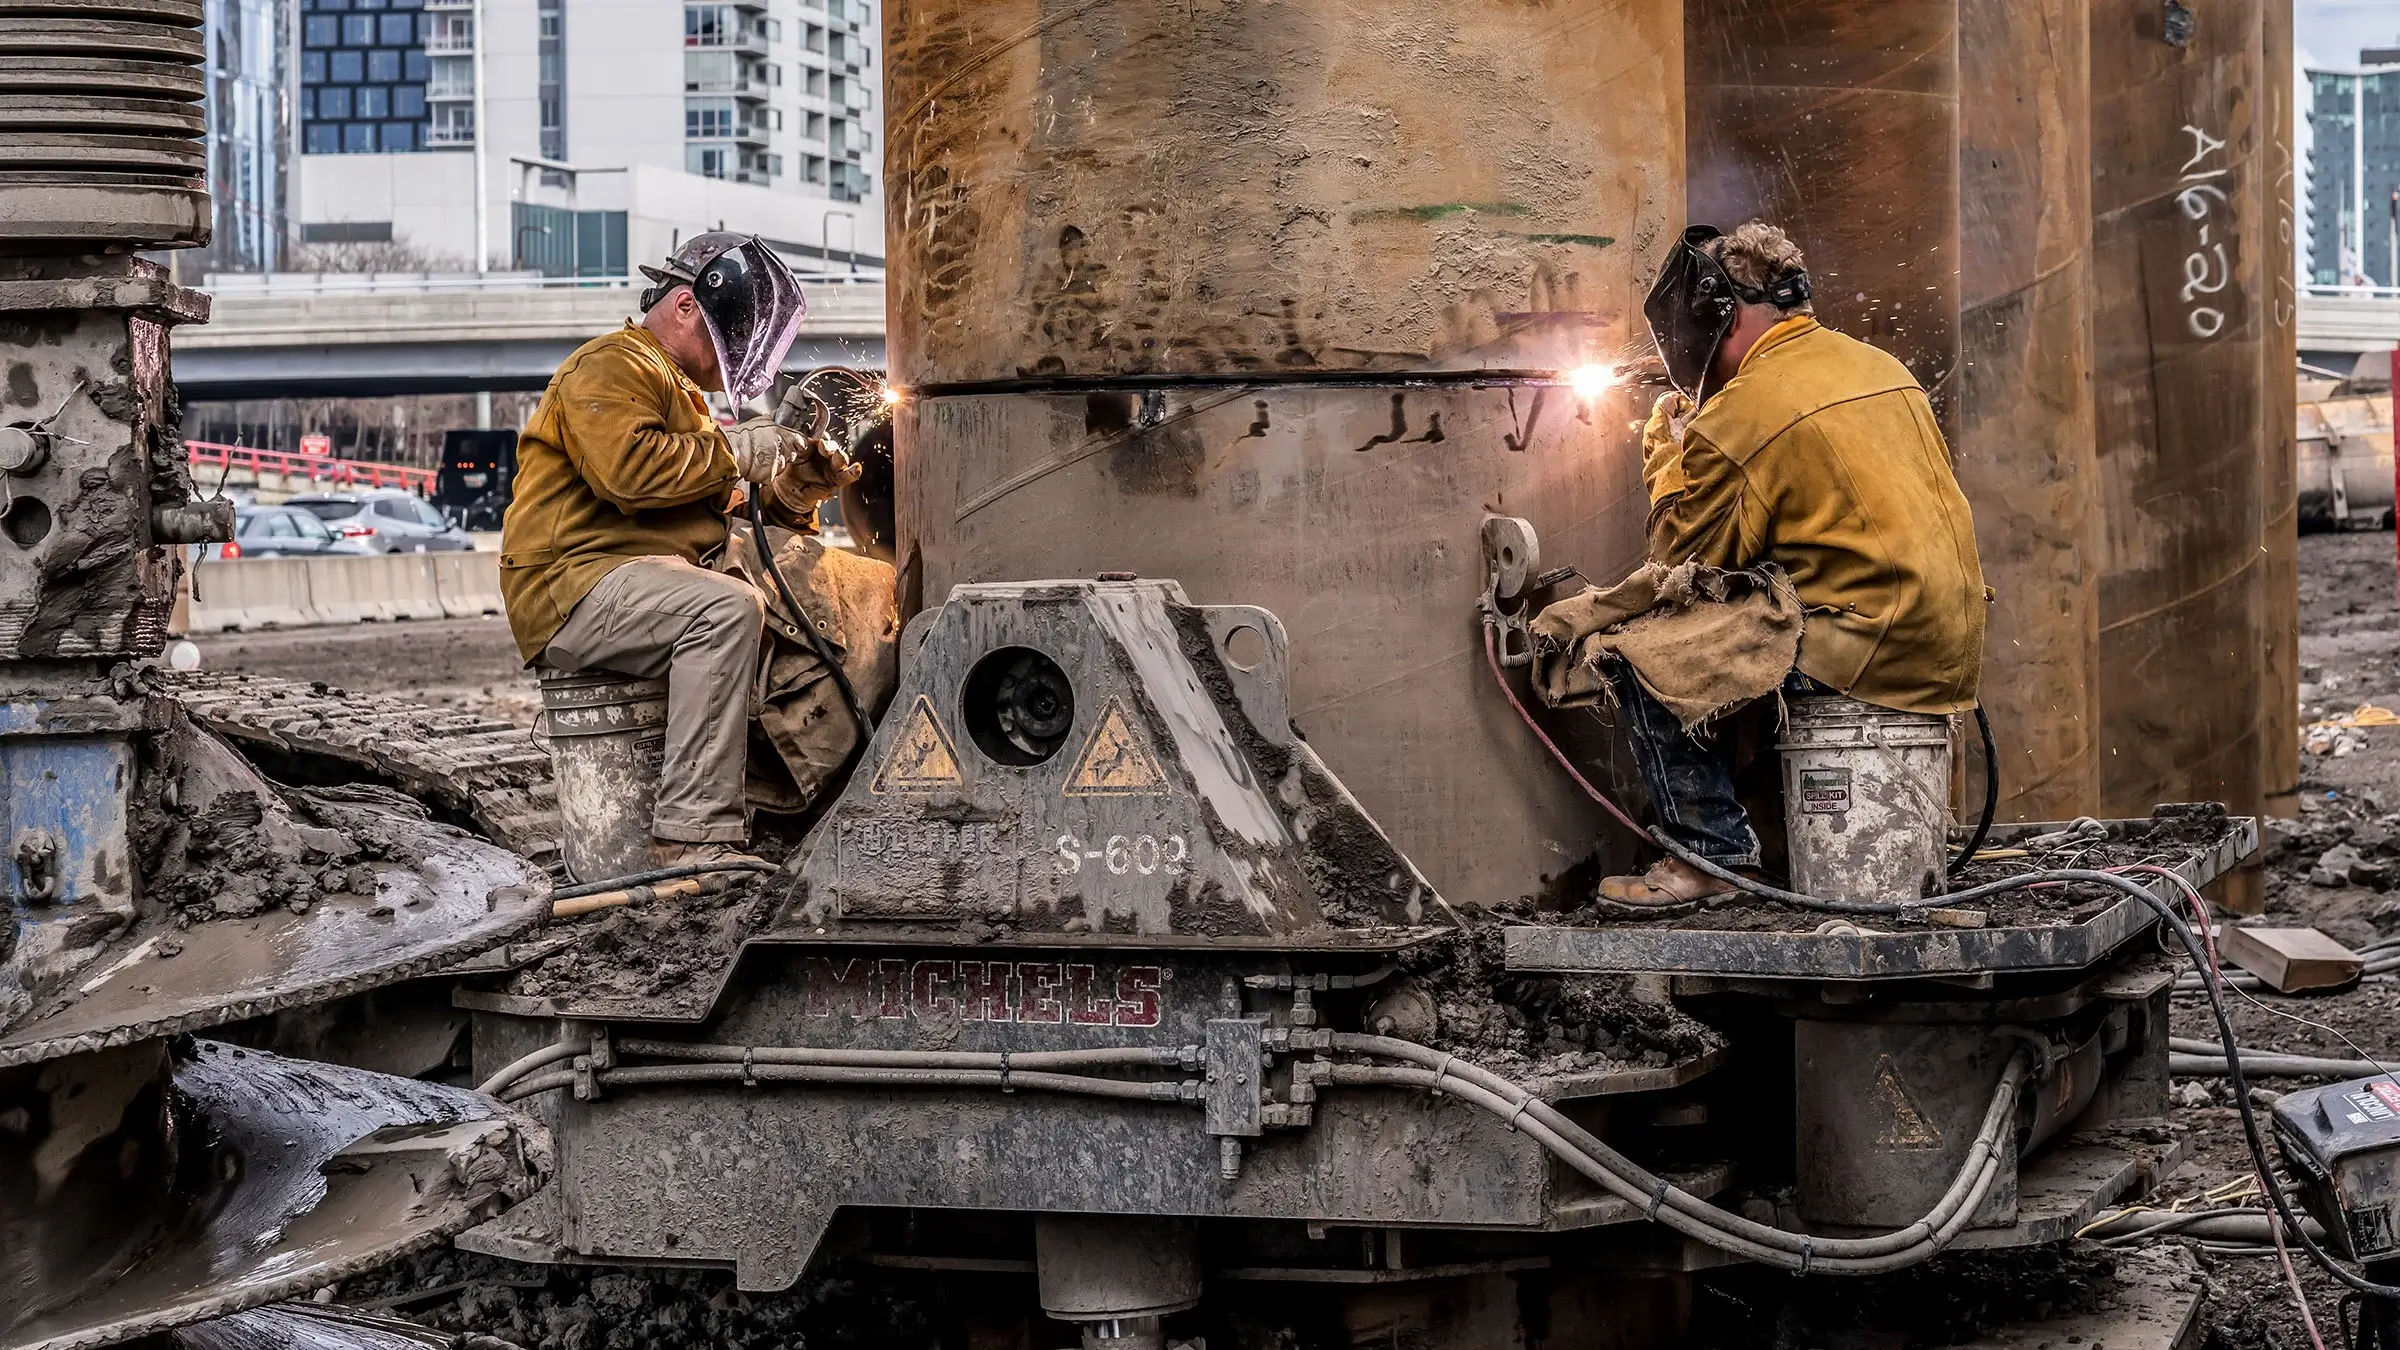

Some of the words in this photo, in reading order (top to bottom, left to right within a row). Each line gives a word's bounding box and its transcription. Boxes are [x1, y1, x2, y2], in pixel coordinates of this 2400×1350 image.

[2175, 124, 2228, 338] A16-20
[1811, 802, 1838, 811] INSIDE
[1829, 791, 1843, 800] KIT
[1056, 834, 1186, 875] S-609
[2350, 1092, 2396, 1120] LINCOLN
